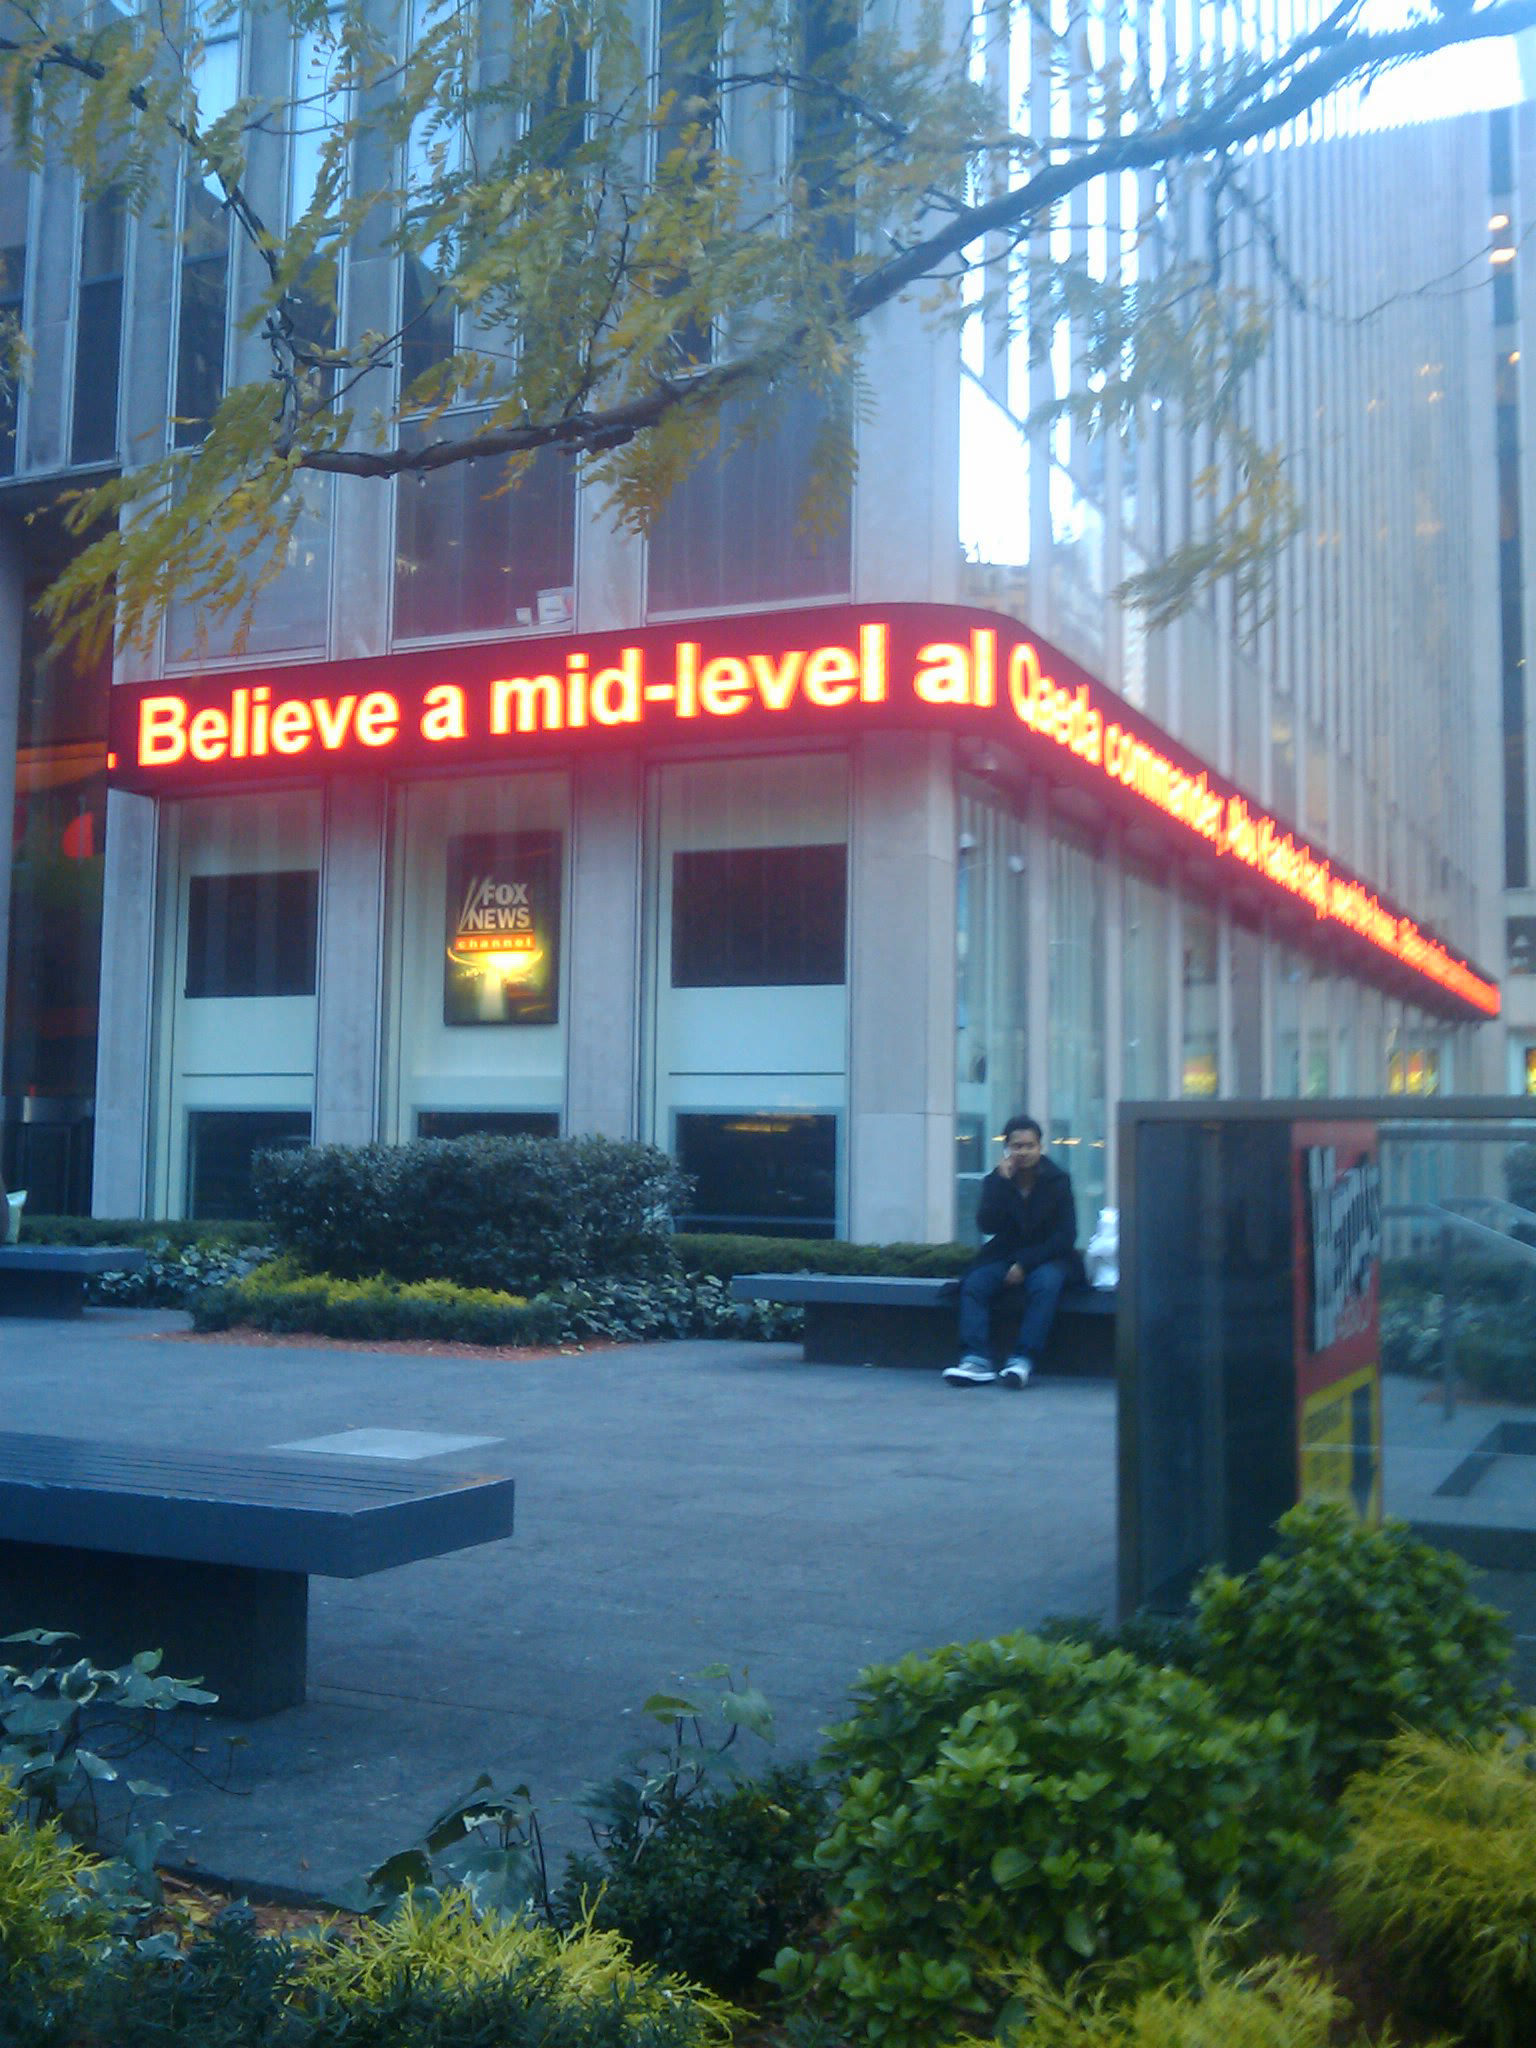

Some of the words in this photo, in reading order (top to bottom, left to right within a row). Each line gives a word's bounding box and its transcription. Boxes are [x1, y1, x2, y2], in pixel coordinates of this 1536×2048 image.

[138, 686, 399, 767] Believe
[420, 684, 467, 741] a
[489, 622, 890, 736] mid-level
[913, 628, 998, 708] al
[1008, 642, 1103, 766] Qaeda
[482, 883, 529, 906] FOX
[468, 907, 530, 930] NEWS
[457, 936, 532, 950] channel
